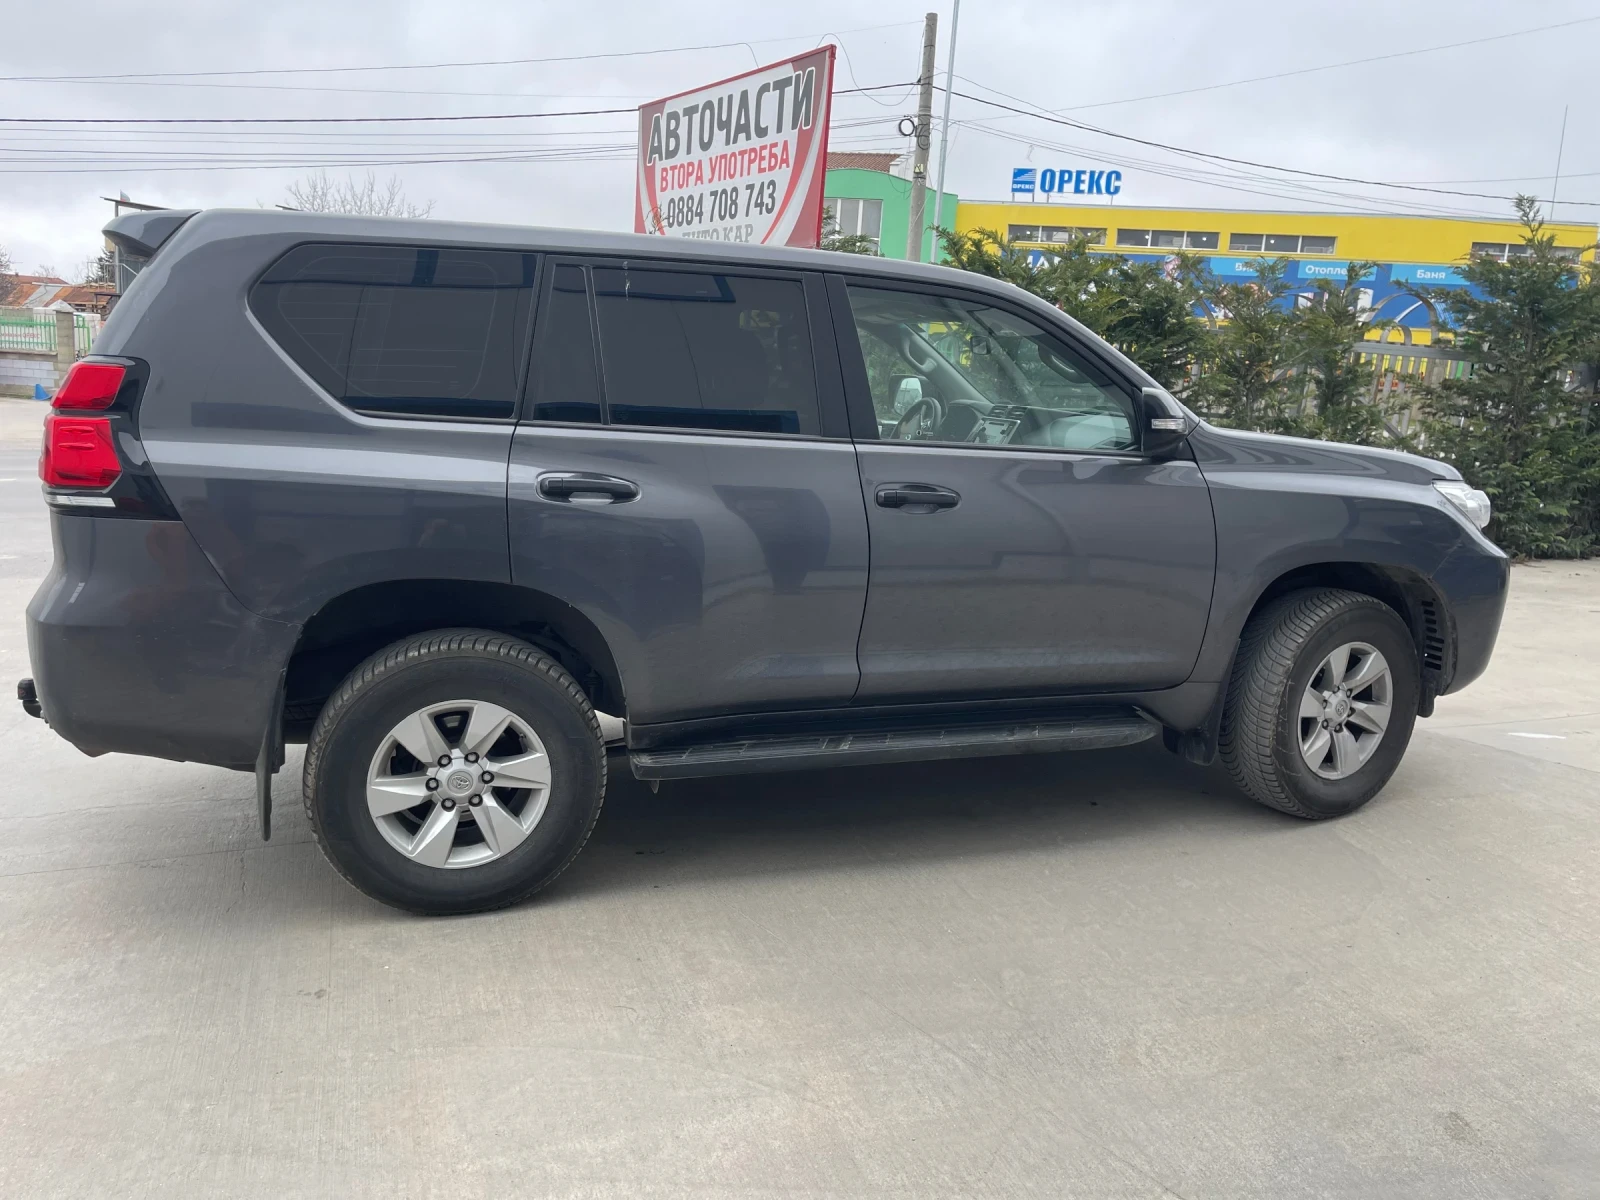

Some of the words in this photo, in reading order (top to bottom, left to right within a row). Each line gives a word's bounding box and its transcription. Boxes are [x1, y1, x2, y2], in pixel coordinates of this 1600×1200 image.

[647, 68, 815, 166] АВТОЧАСТИ
[660, 159, 704, 192] ВТОРА
[708, 139, 790, 184] УПОТРЕБА
[1039, 168, 1122, 195] ОРЕКС
[667, 193, 704, 228] 0884
[709, 186, 739, 222] 708
[745, 179, 777, 218] 743
[1305, 265, 1348, 275] Отопле
[1416, 269, 1446, 279] Баня
